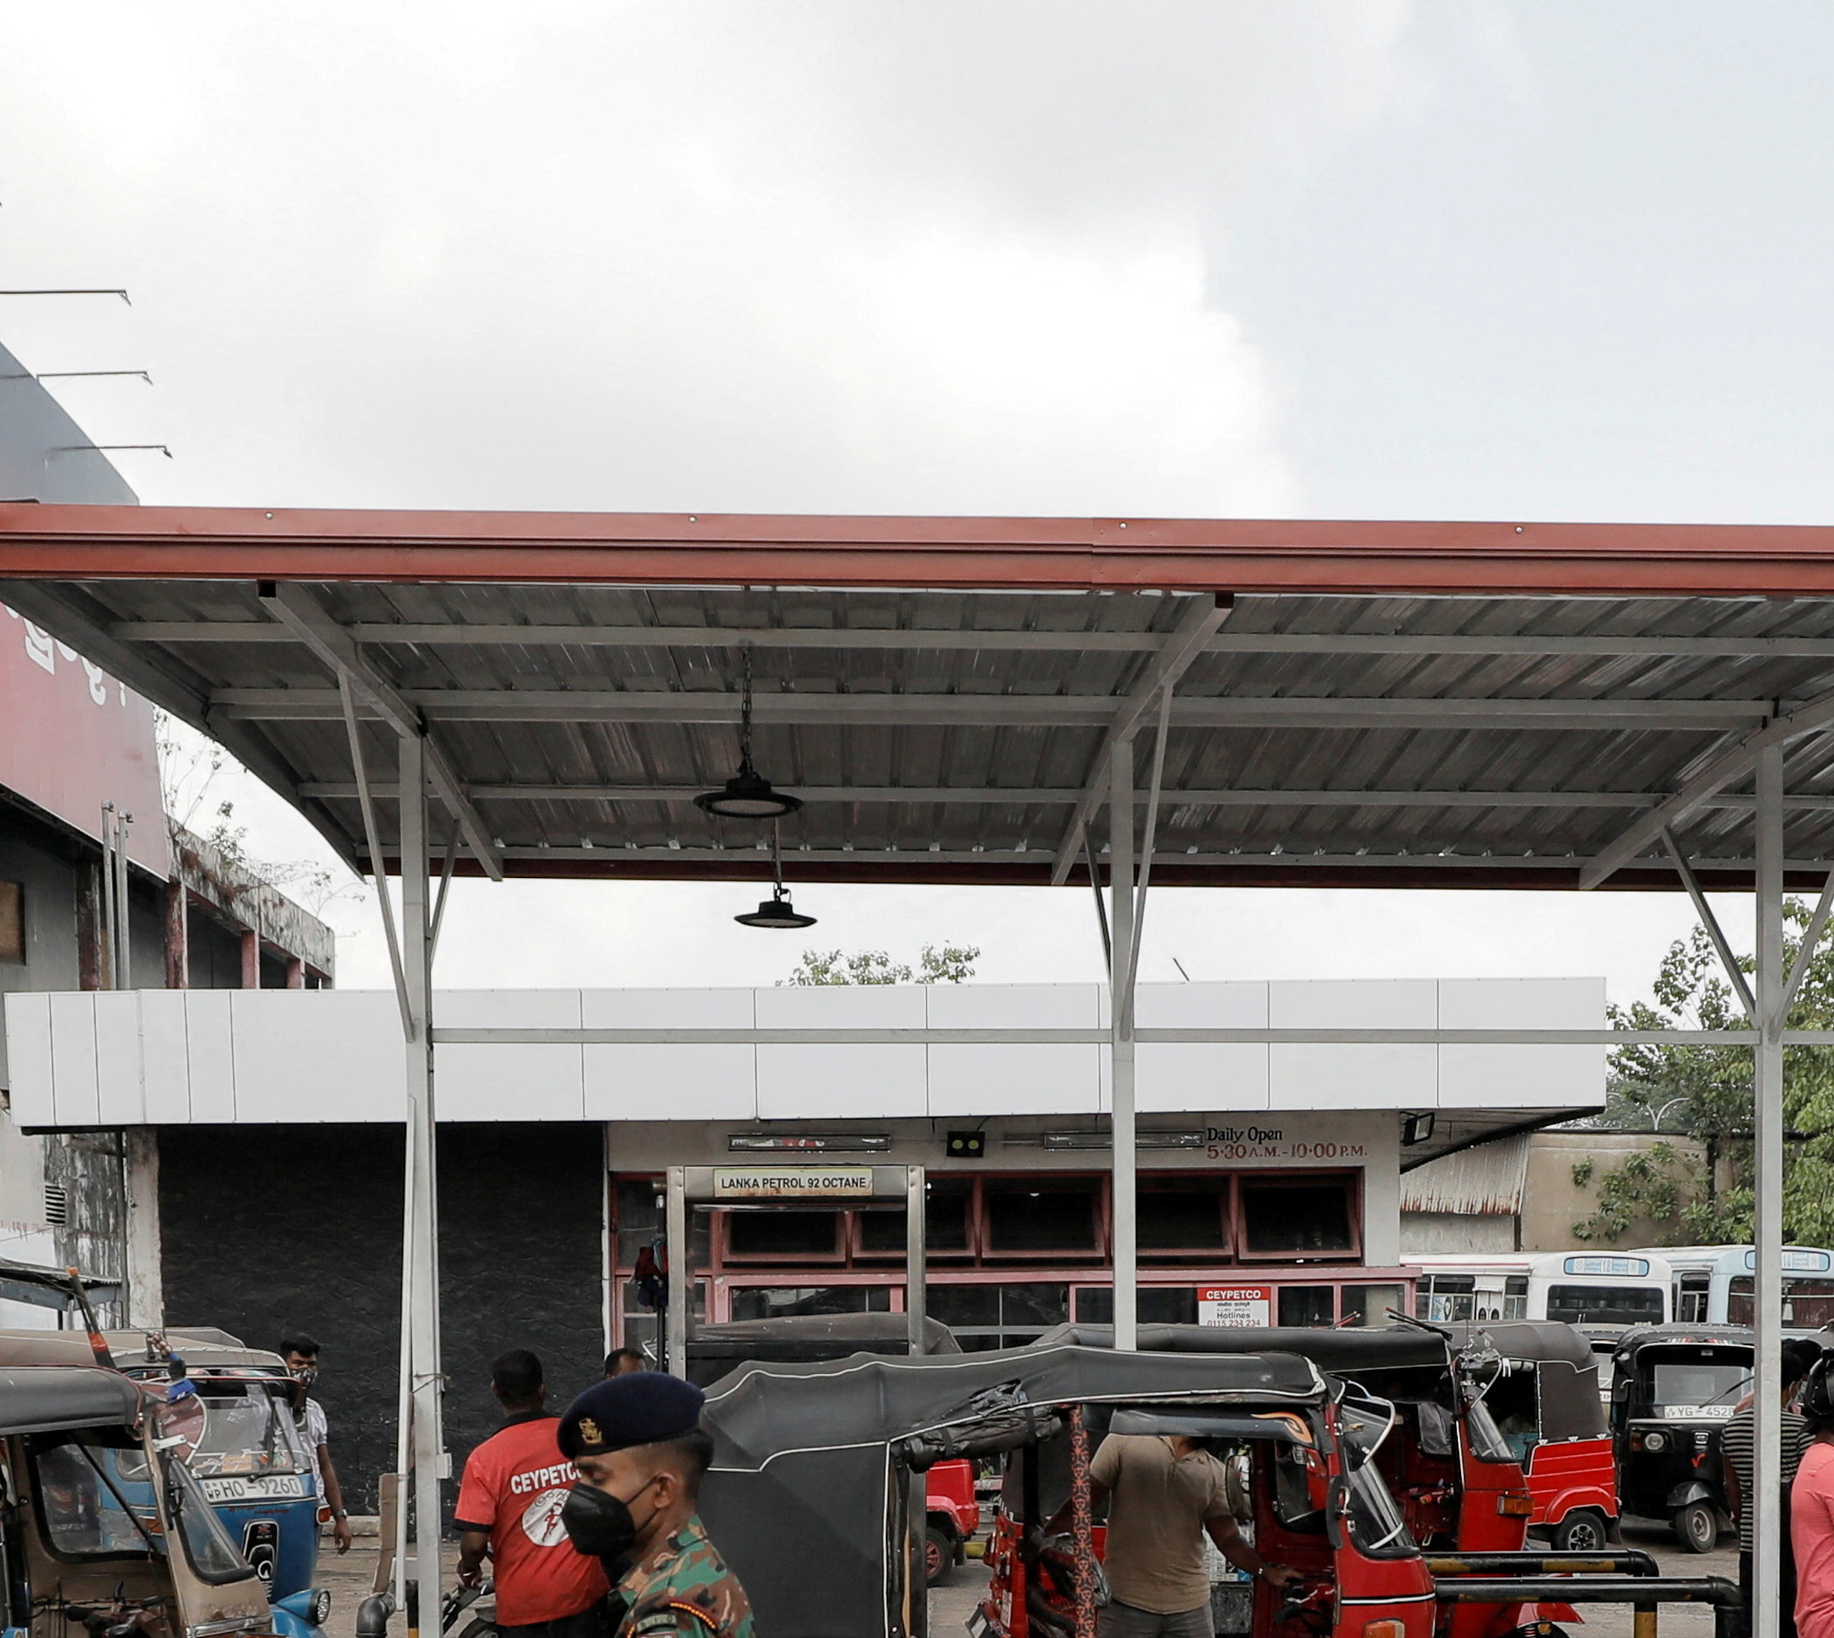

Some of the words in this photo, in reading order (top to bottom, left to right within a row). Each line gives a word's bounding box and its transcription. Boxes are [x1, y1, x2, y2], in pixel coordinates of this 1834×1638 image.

[1207, 1127, 1244, 1143] Daily
[1248, 1127, 1282, 1144] Open
[721, 1178, 759, 1189] LANKA
[762, 1178, 805, 1189] PETROL
[807, 1178, 820, 1189] 92
[822, 1178, 866, 1189] OCTANE
[1206, 1290, 1261, 1299] CEYPETCO
[1217, 1312, 1251, 1320] Hotlines
